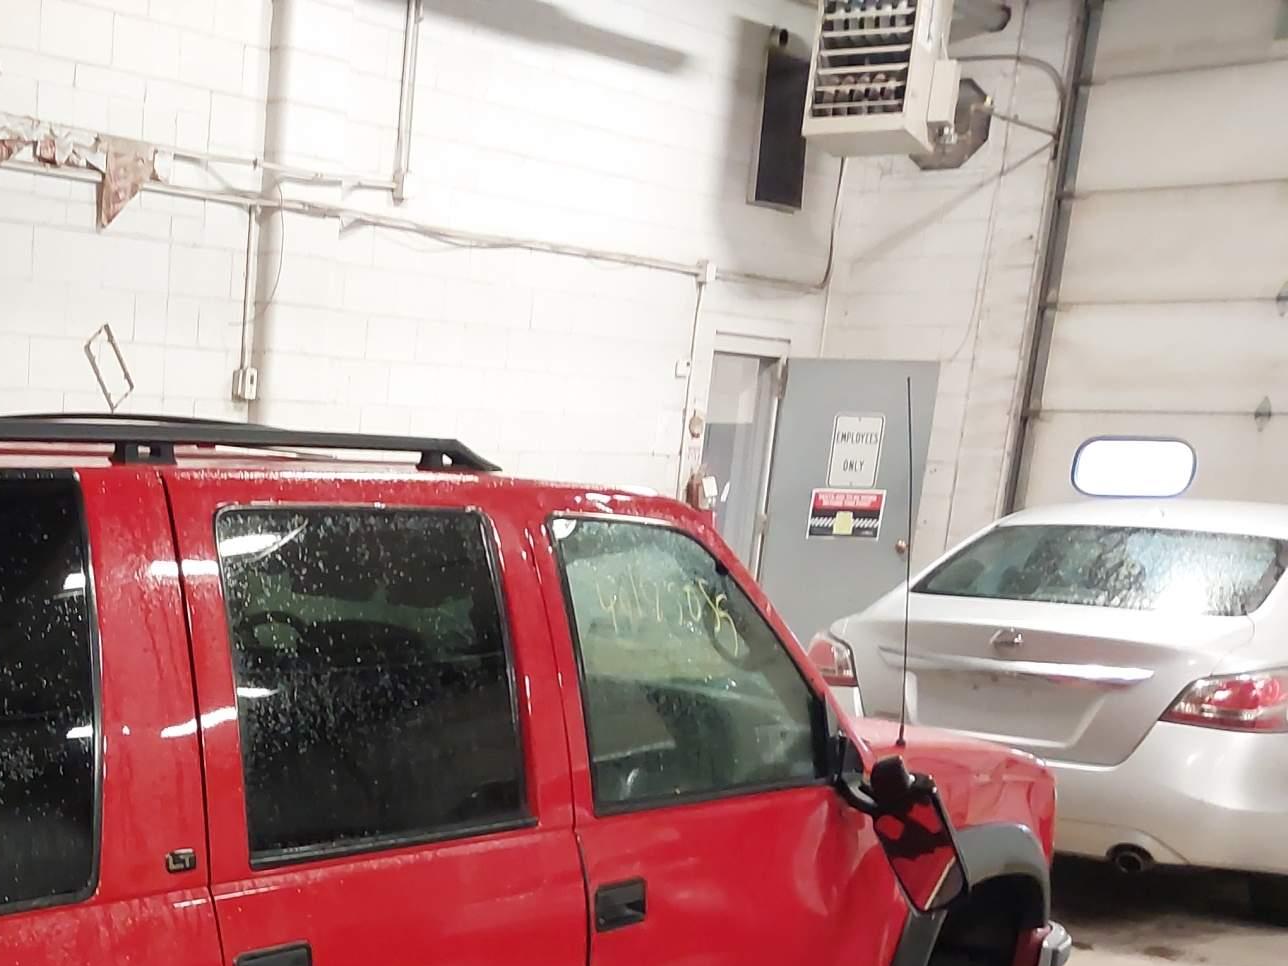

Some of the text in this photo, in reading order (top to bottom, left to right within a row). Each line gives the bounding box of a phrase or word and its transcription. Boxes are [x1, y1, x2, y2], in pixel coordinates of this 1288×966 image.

[836, 431, 879, 445] EMPLOYEES
[842, 459, 864, 472] ONLY
[168, 853, 194, 870] LT
